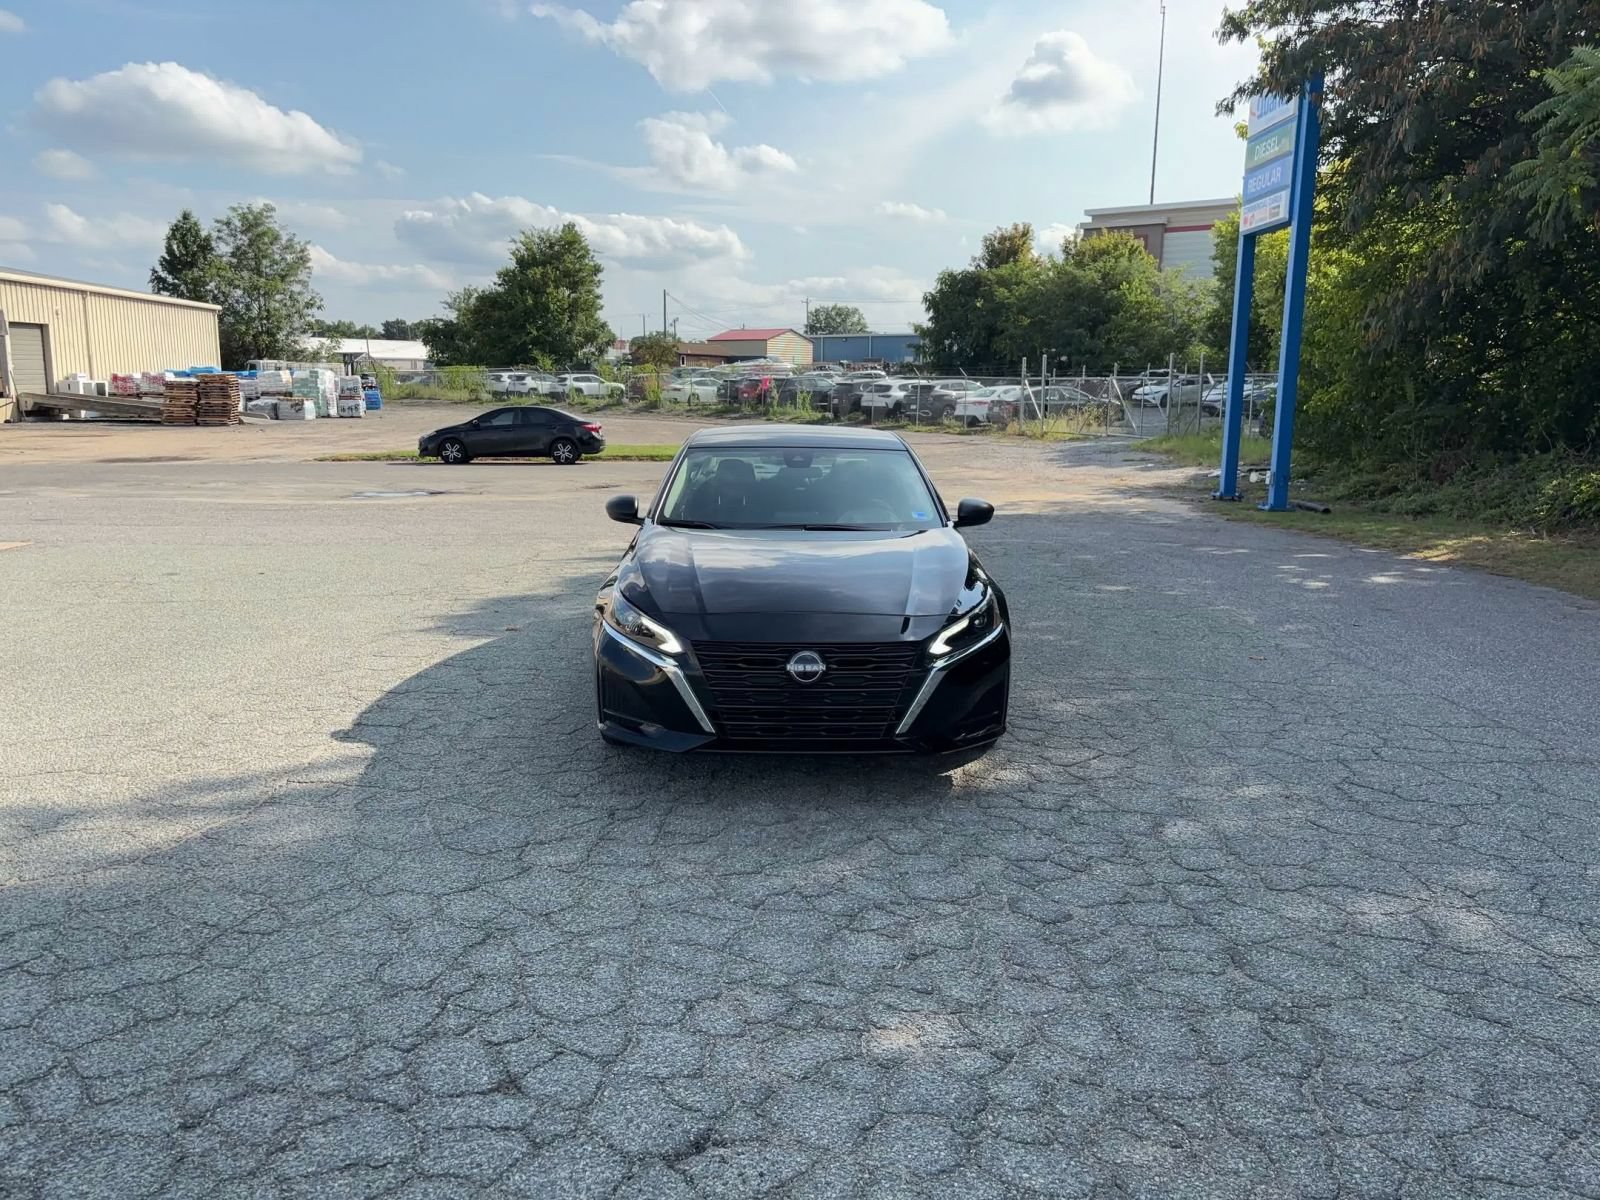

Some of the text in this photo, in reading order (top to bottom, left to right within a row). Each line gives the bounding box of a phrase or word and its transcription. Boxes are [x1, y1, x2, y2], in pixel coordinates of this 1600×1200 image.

[1254, 135, 1280, 161] DIESEL
[1247, 166, 1282, 193] REGULAR
[786, 663, 826, 671] NISSAN
